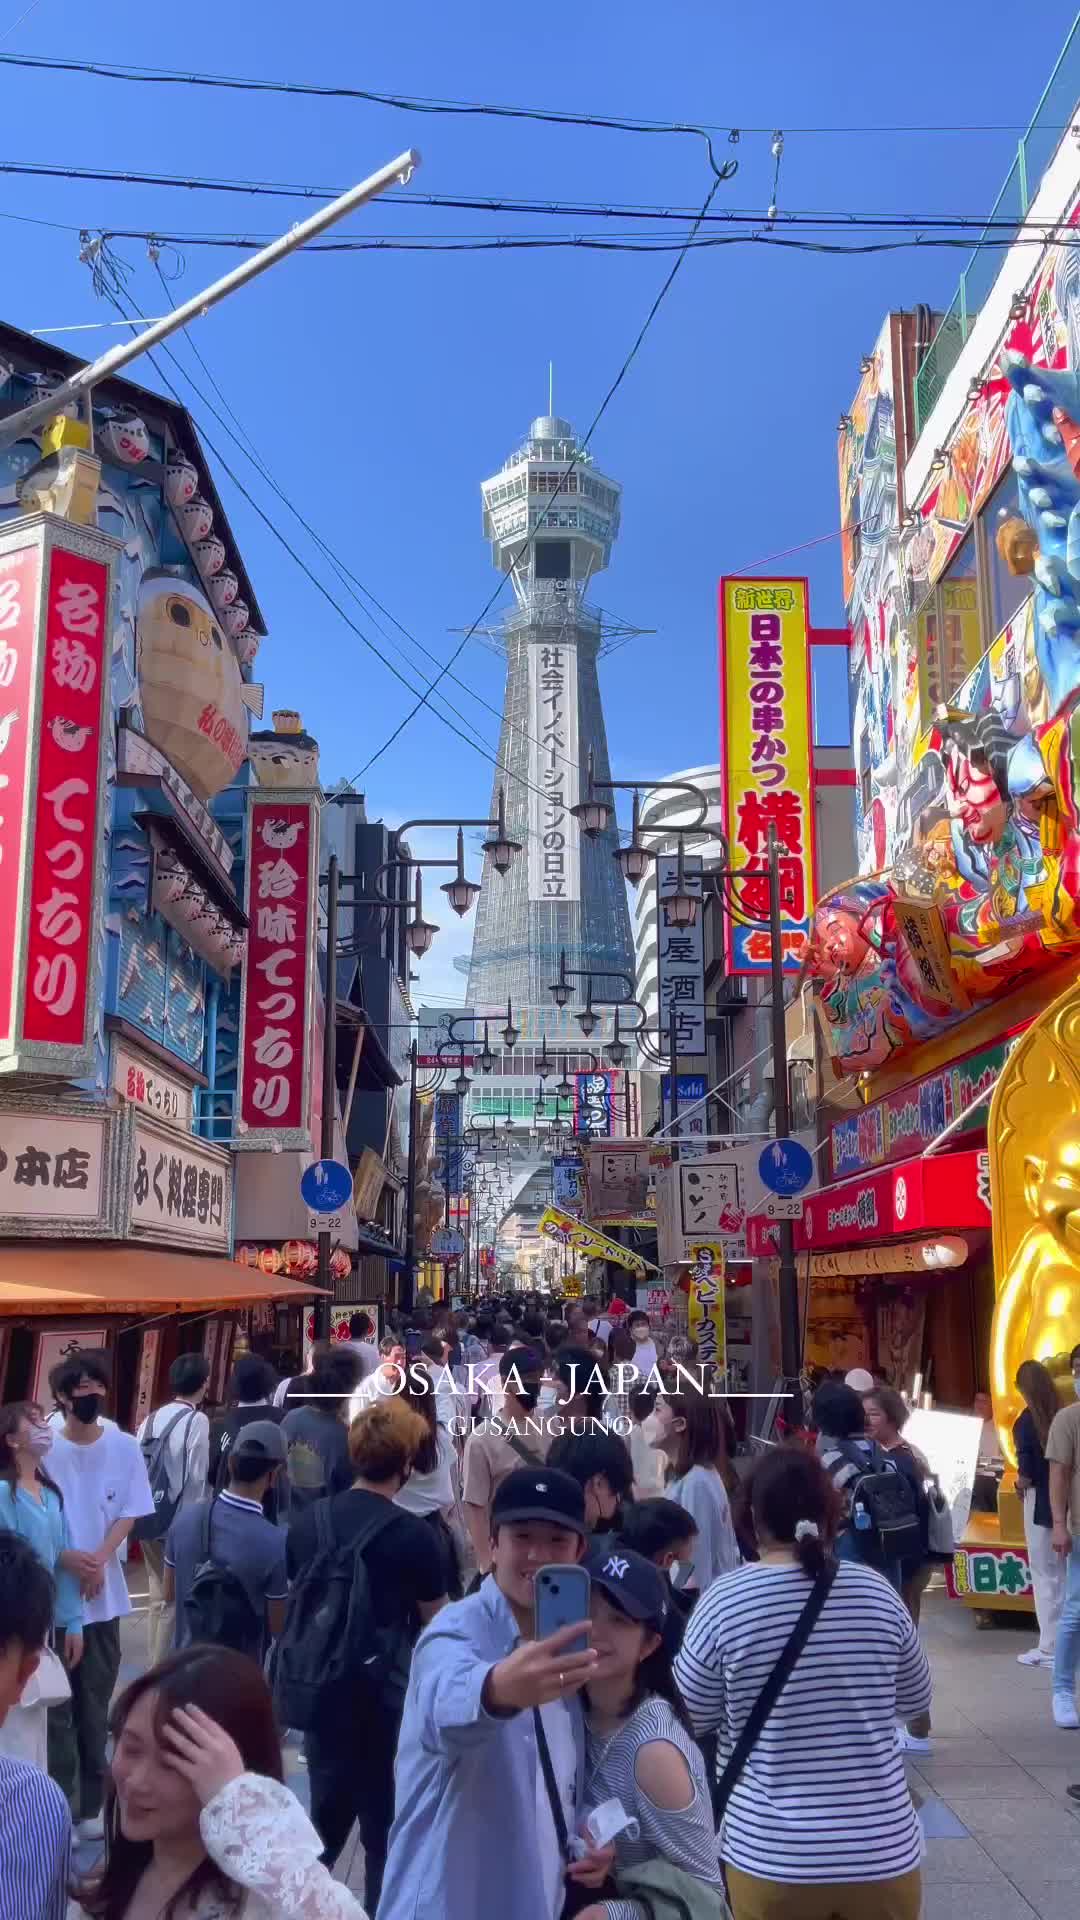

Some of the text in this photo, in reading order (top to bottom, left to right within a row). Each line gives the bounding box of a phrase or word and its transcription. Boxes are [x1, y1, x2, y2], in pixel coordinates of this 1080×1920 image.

[735, 588, 795, 610] 新世界
[748, 612, 788, 788] 日本一の串かつ
[541, 647, 566, 898] 社会イノベーションの日立
[0, 1145, 91, 1190] 本店
[133, 1145, 223, 1227] ふぐ料理専門
[602, 1555, 630, 1579] NY
